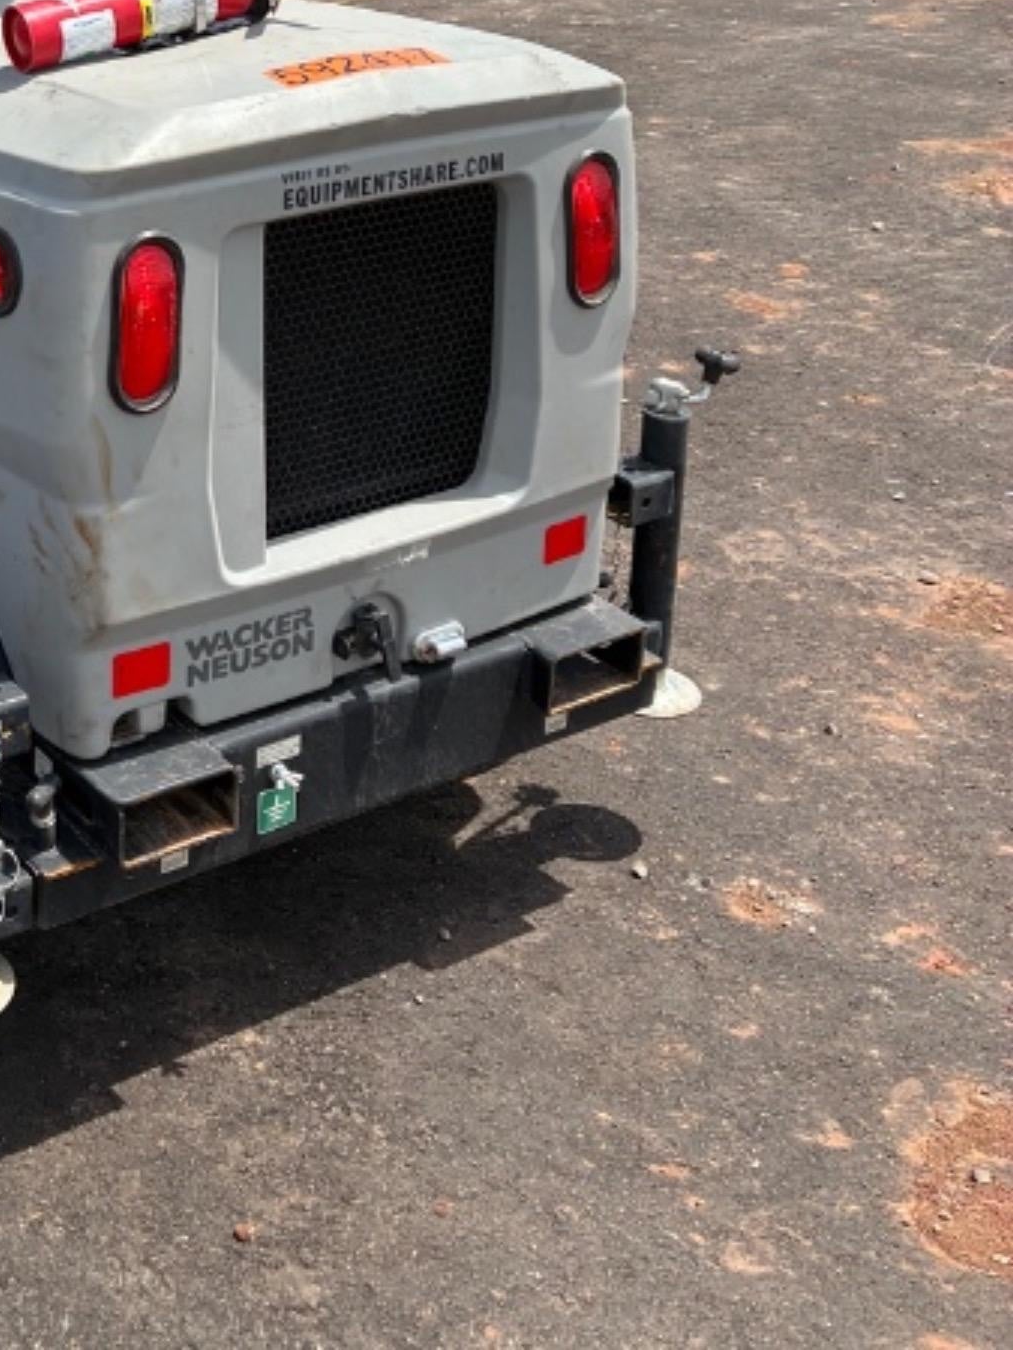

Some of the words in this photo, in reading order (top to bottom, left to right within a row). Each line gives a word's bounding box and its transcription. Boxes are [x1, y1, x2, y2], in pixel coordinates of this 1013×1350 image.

[283, 152, 505, 211] EQUIPMENTSHARE.COM
[185, 606, 315, 659] WACKER
[187, 628, 315, 688] NEUSON
